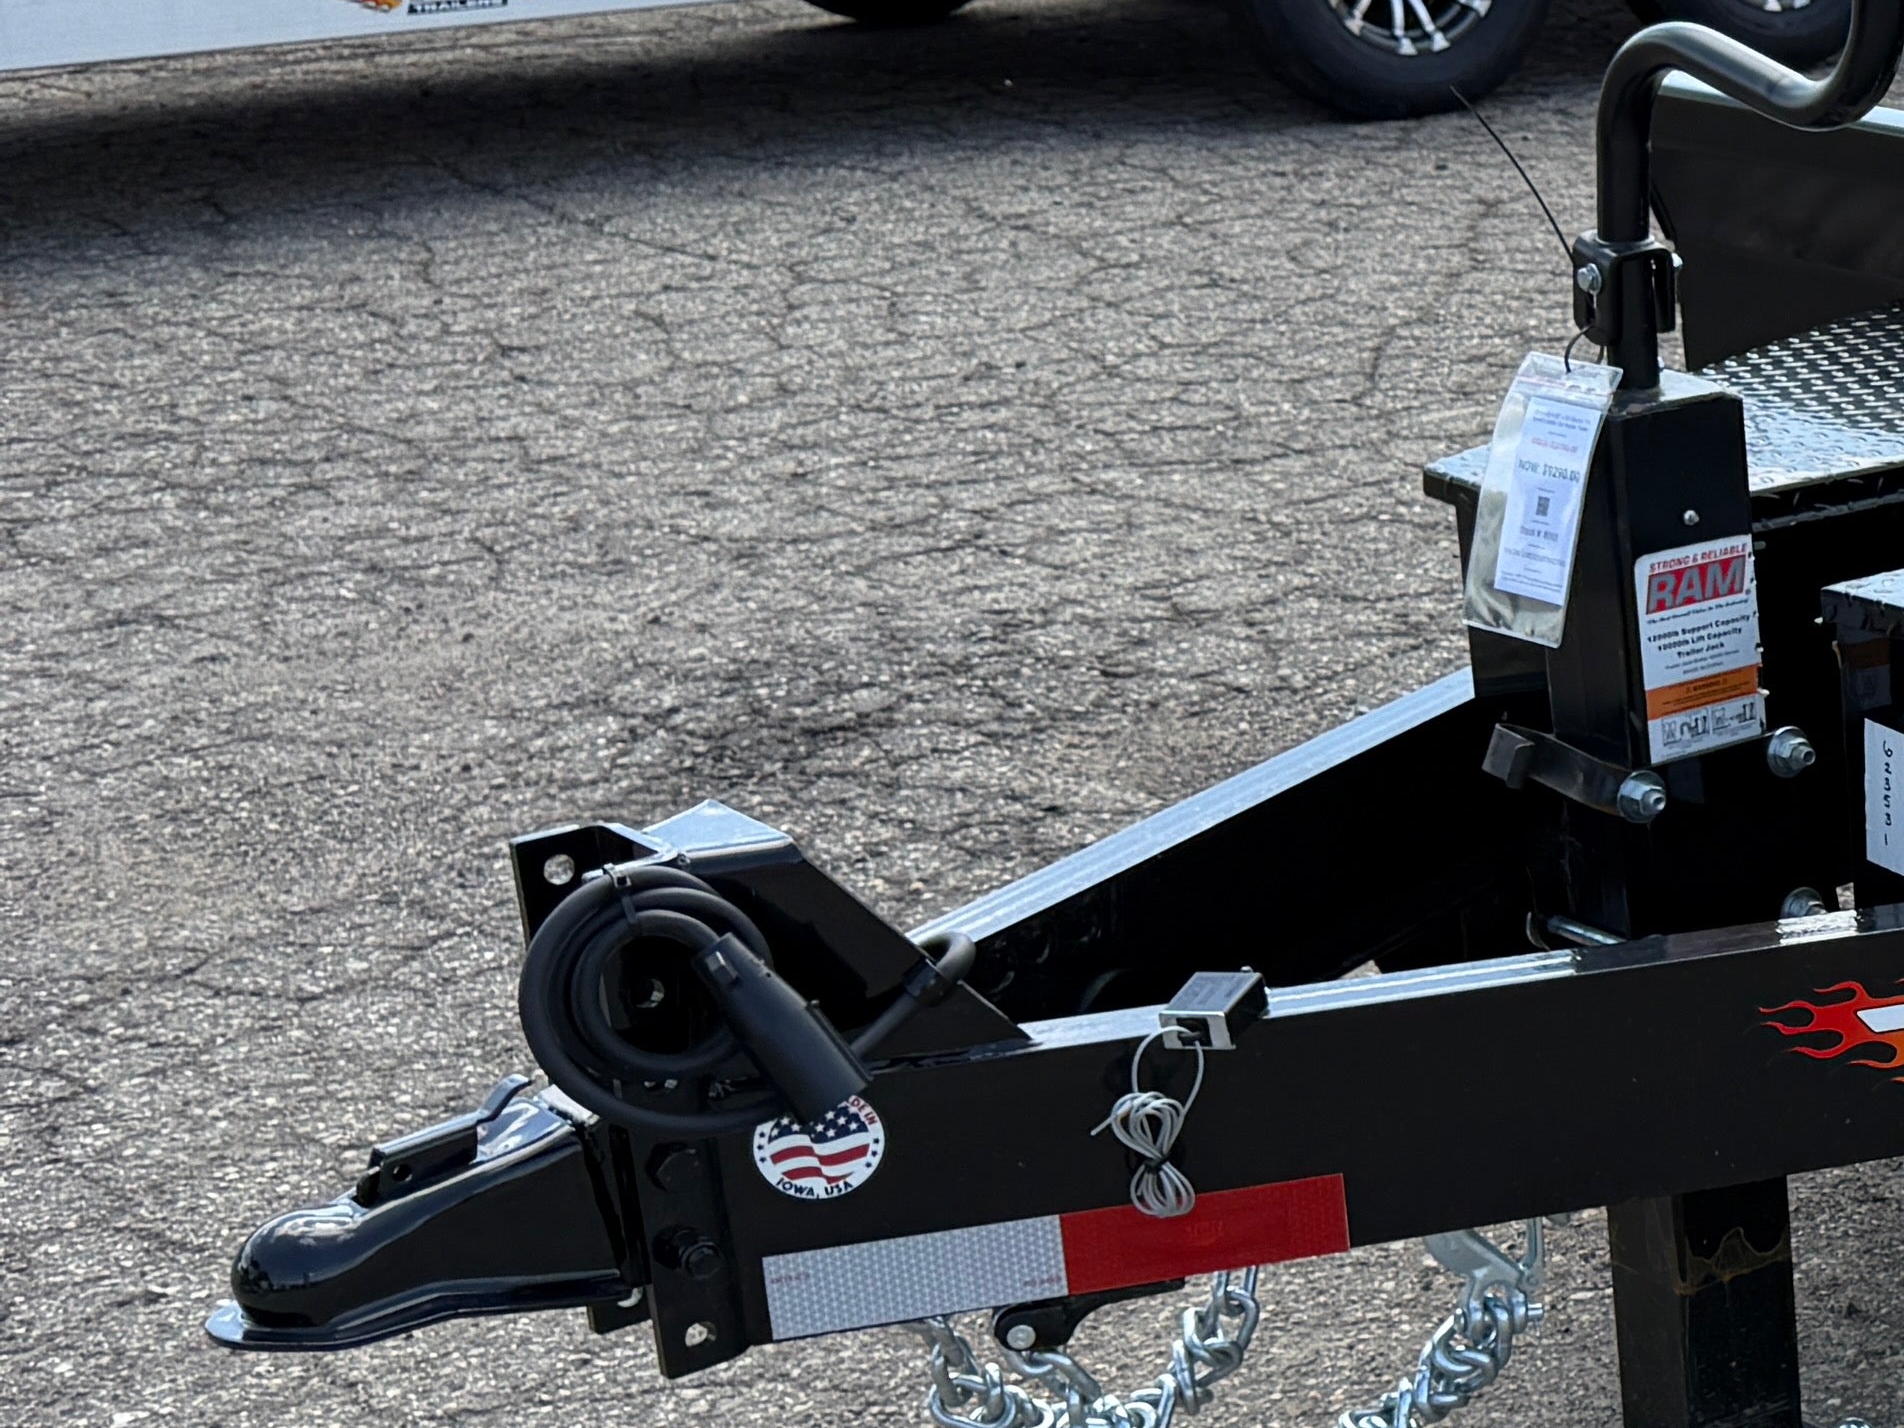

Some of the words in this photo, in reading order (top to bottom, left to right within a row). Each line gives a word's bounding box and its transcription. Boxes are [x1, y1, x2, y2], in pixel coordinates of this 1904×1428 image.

[1649, 555, 1691, 573] STRONG
[1692, 553, 1699, 564] &
[1700, 542, 1748, 560] RELIABLE
[1648, 557, 1745, 610] RAM
[1681, 621, 1713, 636] Support
[1715, 614, 1750, 629] Capacity
[1707, 627, 1742, 641] Capacity
[1677, 647, 1705, 659] Trailer
[1706, 642, 1725, 653] Jack
[863, 1111, 879, 1127] IN
[775, 1177, 820, 1200] IOWA,
[824, 1180, 854, 1197] USA
